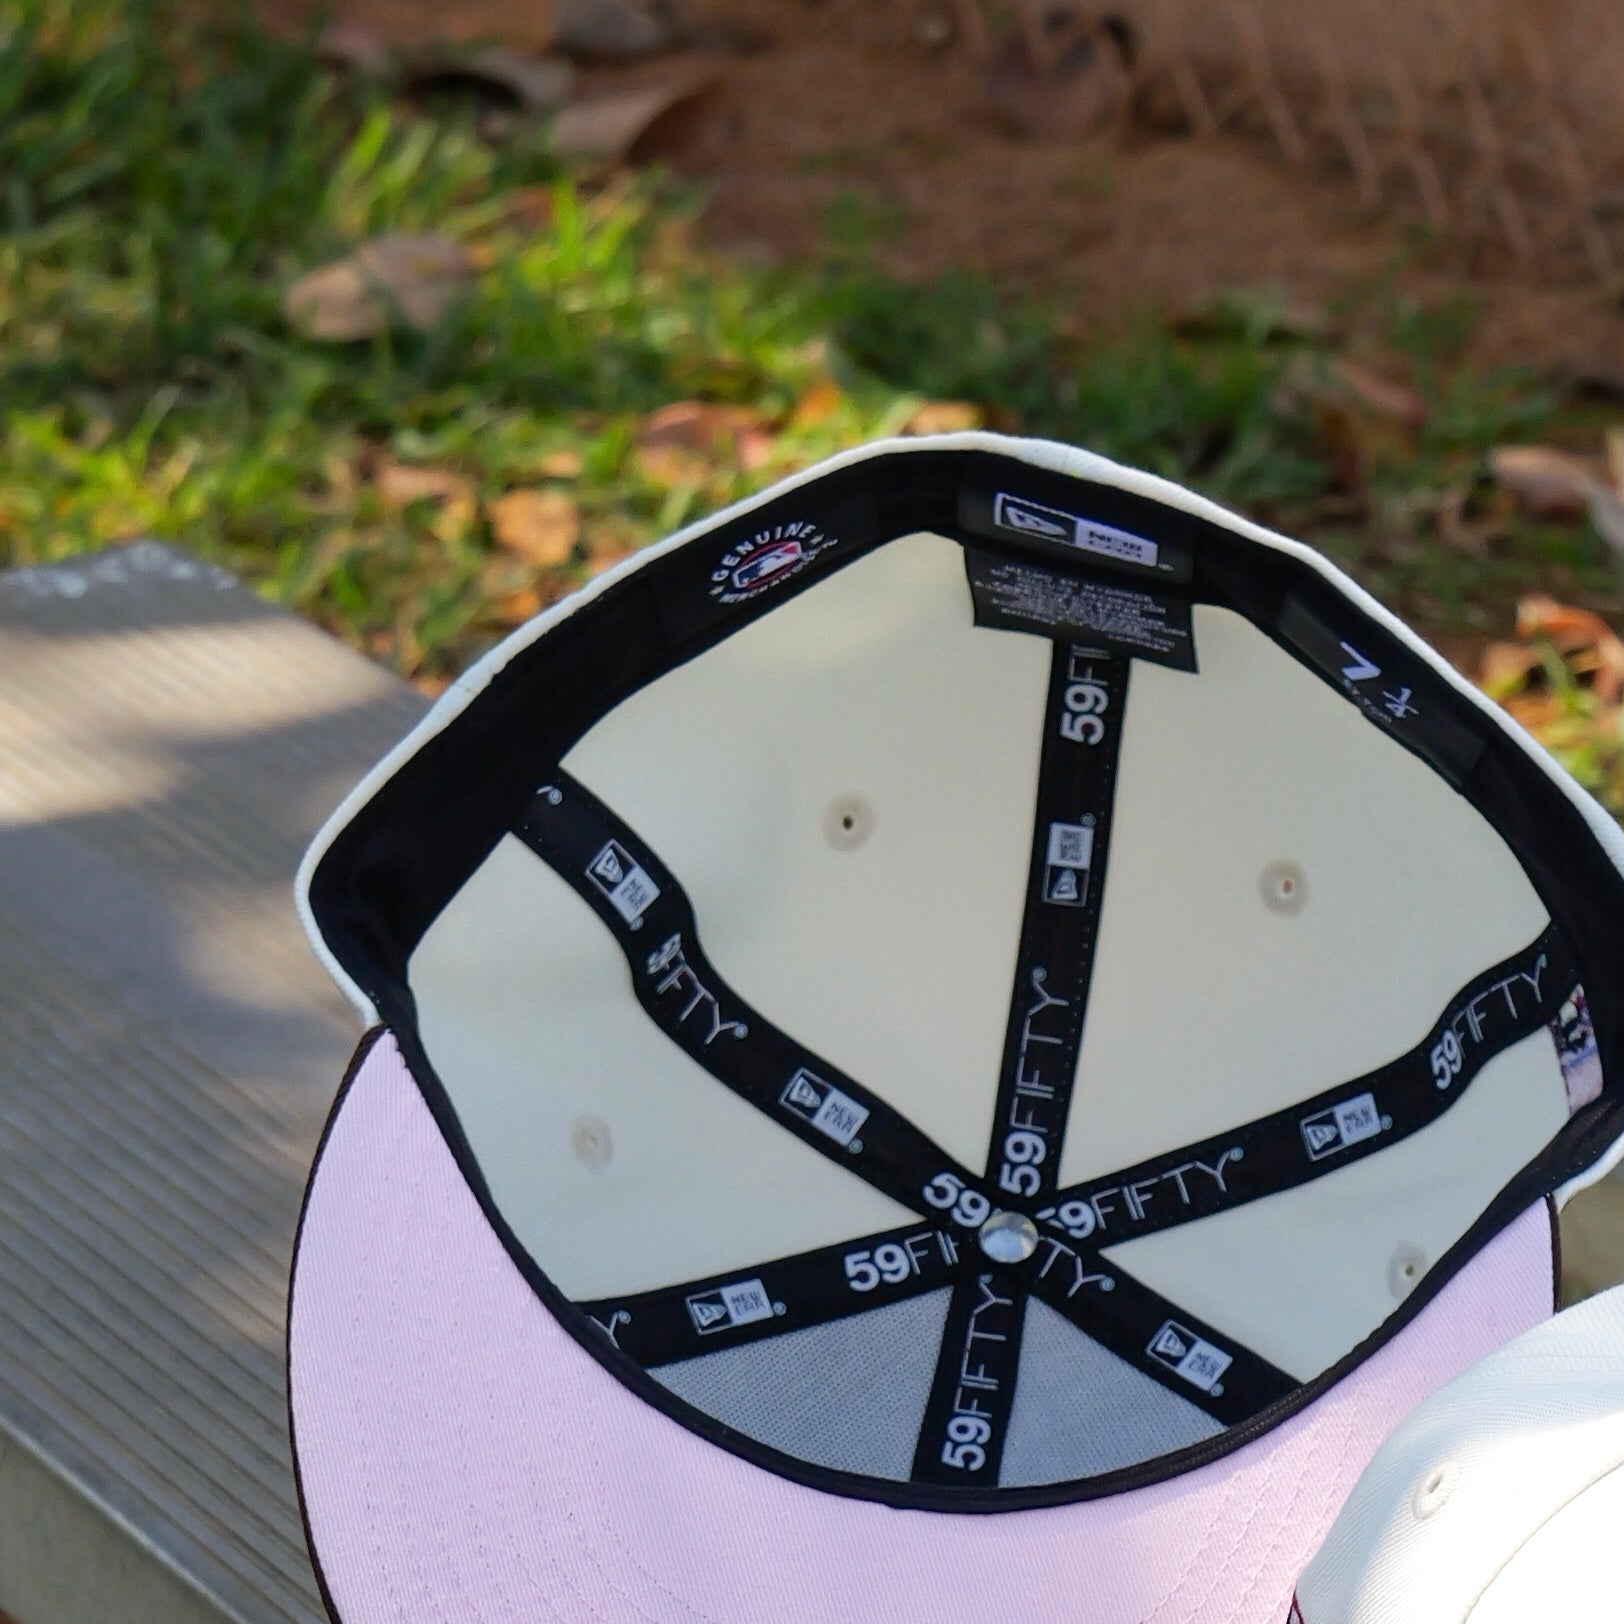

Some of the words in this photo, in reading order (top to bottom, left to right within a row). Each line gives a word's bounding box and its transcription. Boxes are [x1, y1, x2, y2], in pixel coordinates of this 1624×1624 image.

[711, 521, 816, 582] GENUINE
[1059, 644, 1111, 746] 59FI
[1340, 641, 1381, 681] 7
[1000, 979, 1069, 1197] 59FIFTY
[844, 1230, 960, 1292] 59FI
[941, 1280, 1013, 1472] 59FIFTY
